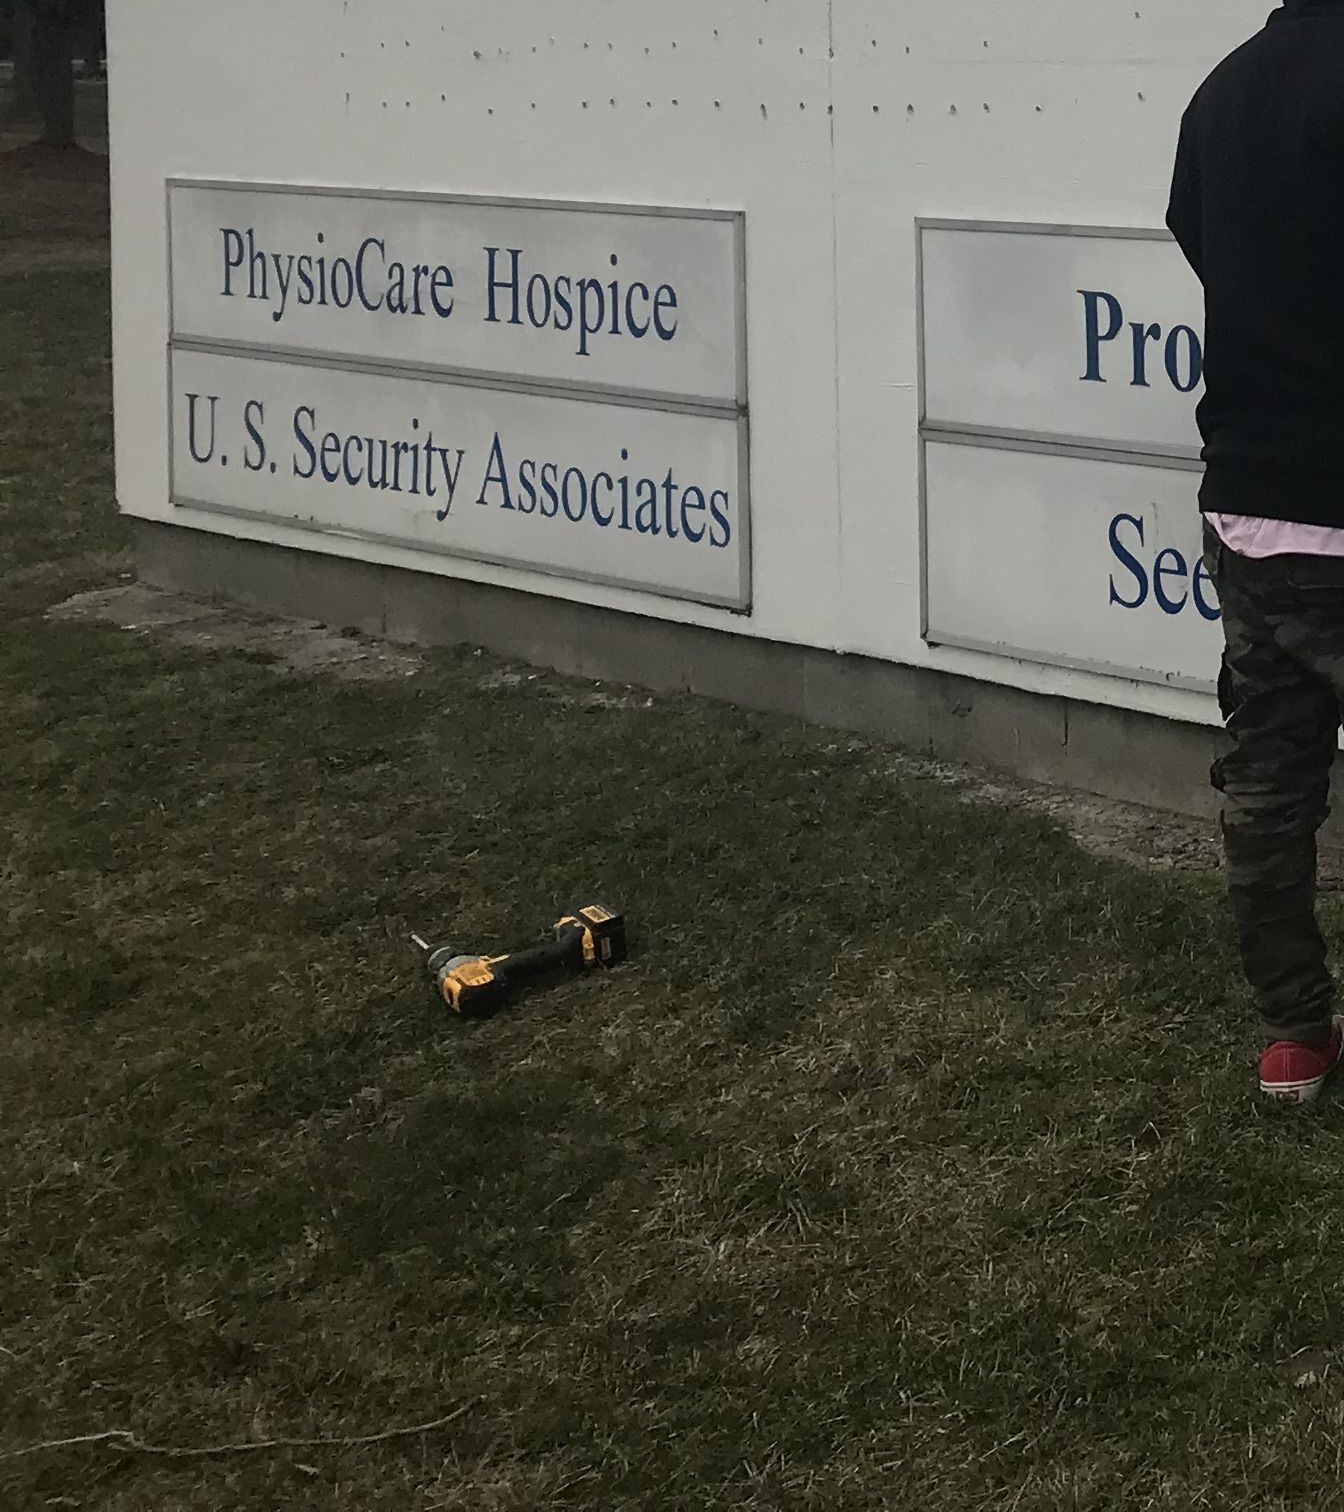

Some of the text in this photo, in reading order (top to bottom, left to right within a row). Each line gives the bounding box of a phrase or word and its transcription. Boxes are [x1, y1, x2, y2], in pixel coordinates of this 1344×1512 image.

[219, 227, 678, 356] PhysioCare Hospice
[185, 393, 731, 548] U. S. Security Associates
[1108, 512, 1222, 620] See
